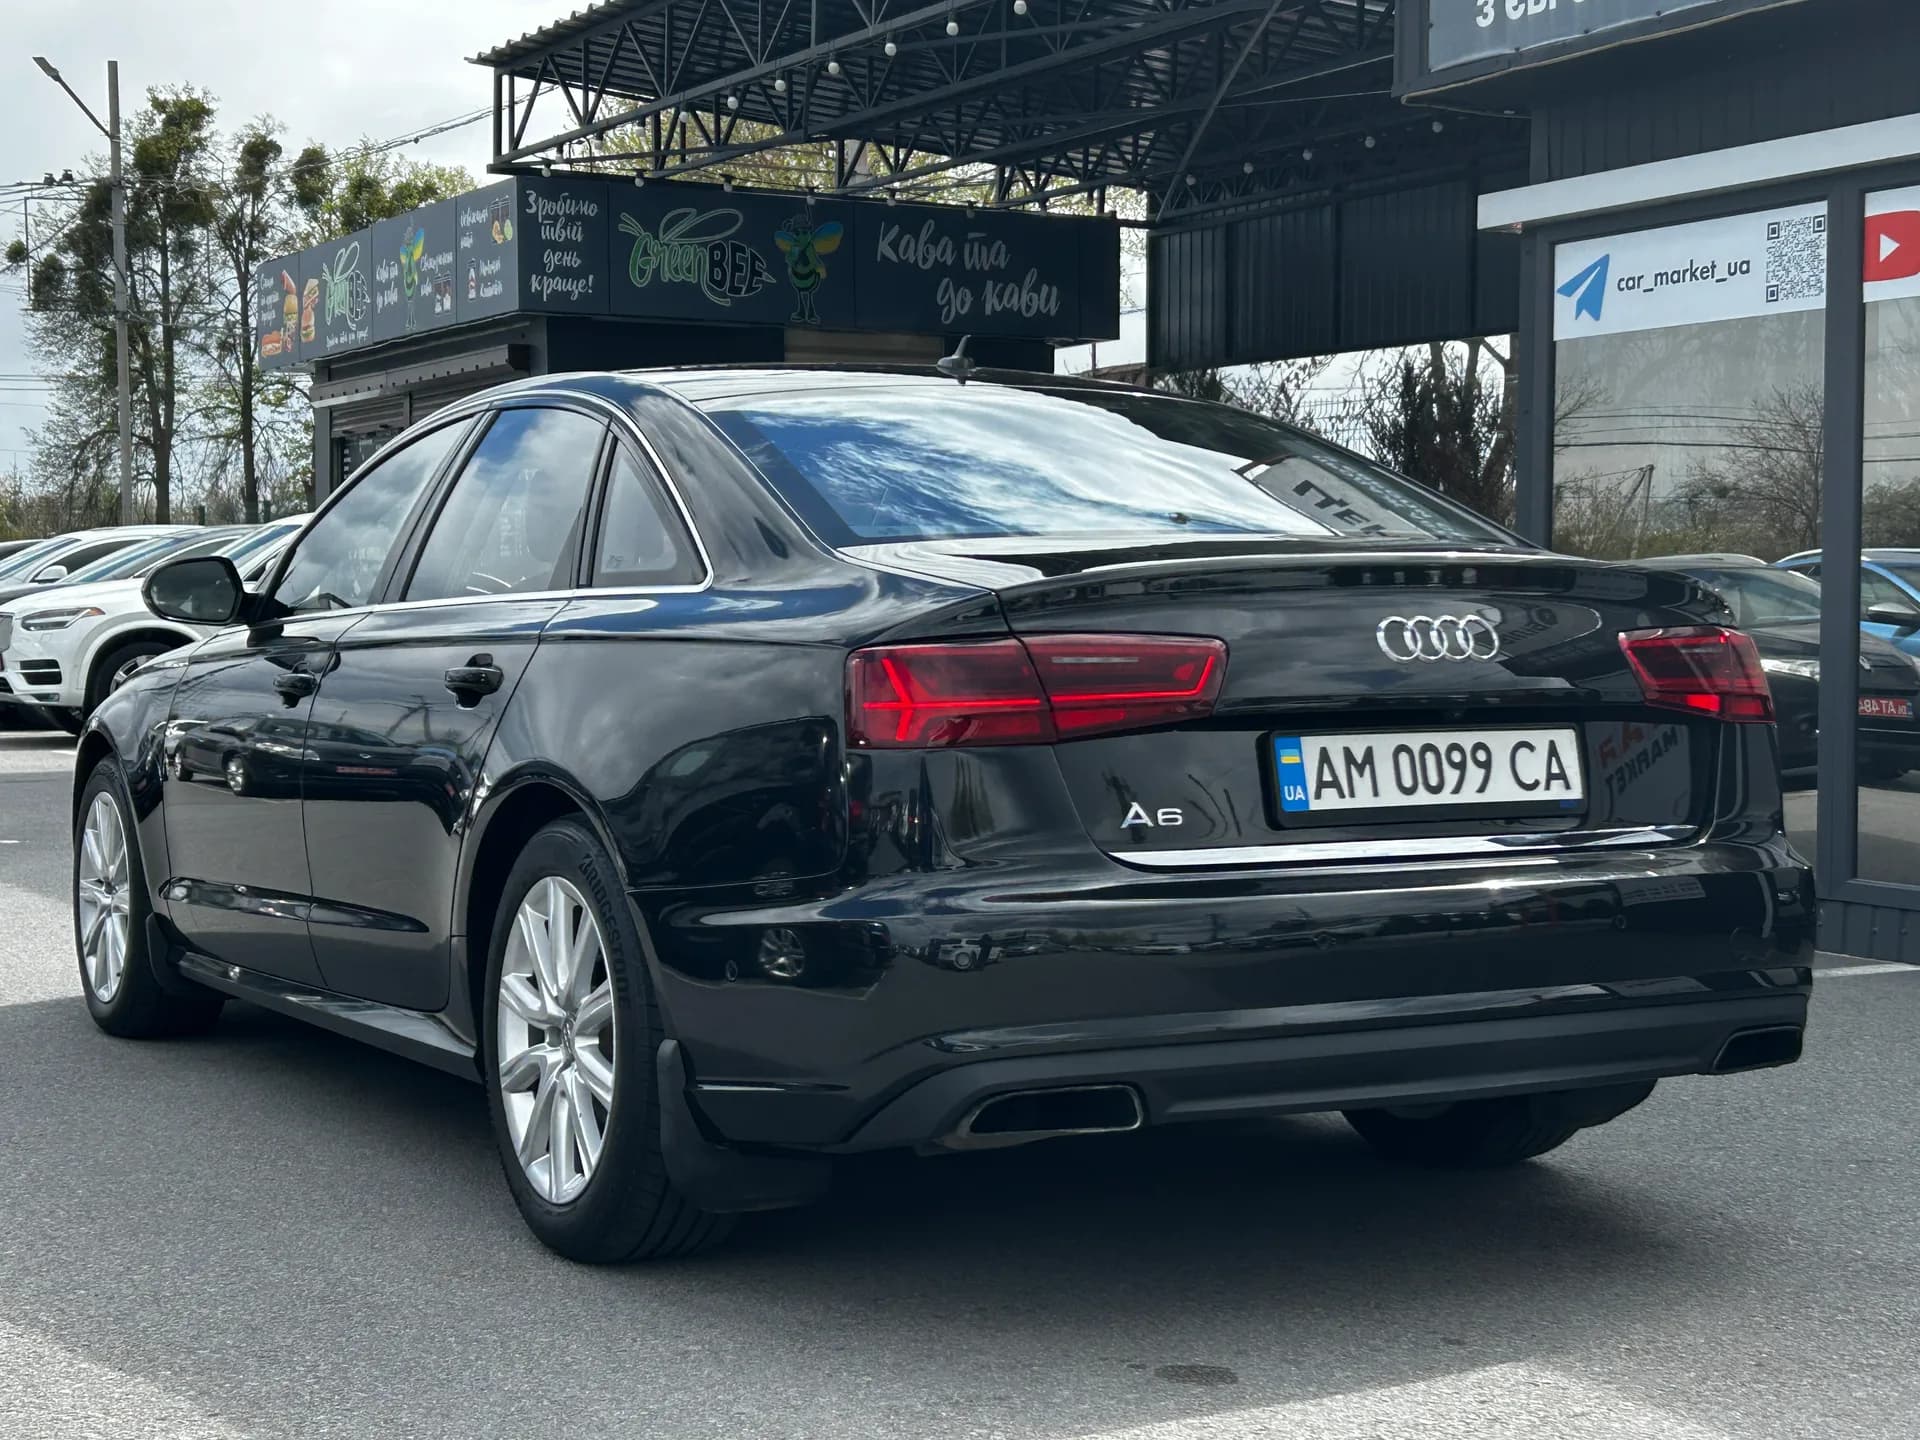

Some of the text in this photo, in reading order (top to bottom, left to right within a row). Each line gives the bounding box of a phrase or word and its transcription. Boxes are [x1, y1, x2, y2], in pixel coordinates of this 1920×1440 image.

[525, 190, 598, 223] Зробимо
[541, 217, 584, 242] твій
[877, 219, 1011, 271] Кава та
[543, 248, 582, 273] день
[529, 274, 595, 302] краще!
[1616, 259, 1751, 293] car_market_ua
[936, 267, 1062, 324] до кави
[1314, 739, 1572, 800] AM 0099 CA
[1284, 785, 1305, 801] UA
[1120, 801, 1184, 829] A6
